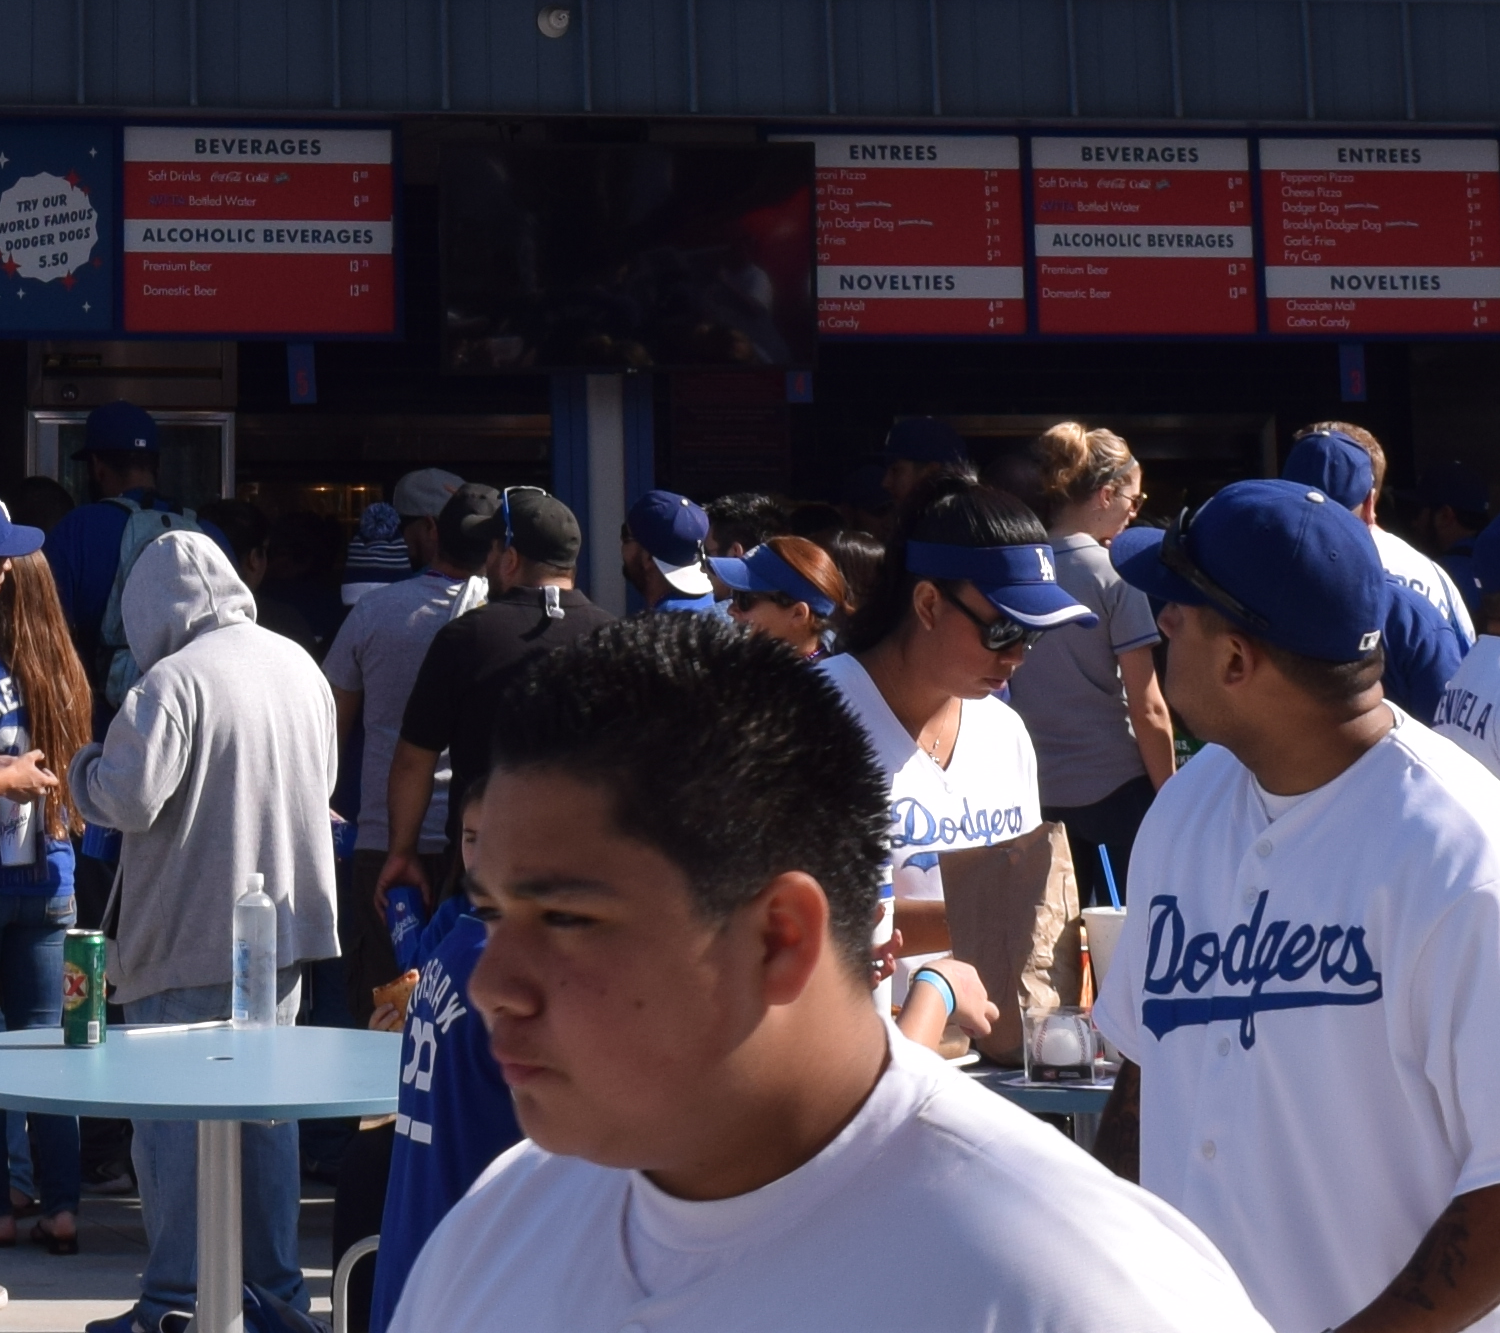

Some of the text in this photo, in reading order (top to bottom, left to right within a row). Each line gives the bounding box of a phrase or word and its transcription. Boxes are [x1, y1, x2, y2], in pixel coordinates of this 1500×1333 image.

[194, 137, 321, 155] BEVERAGES
[848, 143, 937, 161] ENTREES
[1080, 145, 1199, 163] BEVERAGES
[1337, 146, 1421, 163] ENTREES
[147, 169, 167, 181] Soft
[168, 169, 201, 181] Drinks
[1038, 176, 1088, 188] Soft Drinks
[16, 194, 67, 213] TRY OUR
[188, 194, 222, 206] Bottled
[224, 195, 256, 206] Water
[1077, 200, 1140, 212] Bottled Water
[44, 208, 93, 227] FAMOUS
[5, 226, 90, 251] DODGER DOGS
[141, 227, 373, 244] ALCOHOLIC BEVERAGES
[1051, 232, 1234, 248] ALCOHOLIC BEVERAGES
[38, 252, 68, 268] 5.50
[142, 259, 211, 271] Premium Beer
[1040, 263, 1108, 275] Premium Beer
[142, 283, 217, 296] Domestic Beer
[839, 274, 955, 291] NOVELTIES
[1329, 274, 1440, 291] NOVELTIES
[1041, 287, 1110, 298] Domestic Beer
[891, 797, 1023, 847] Dodgers
[1142, 889, 1383, 1051] Dodgers
